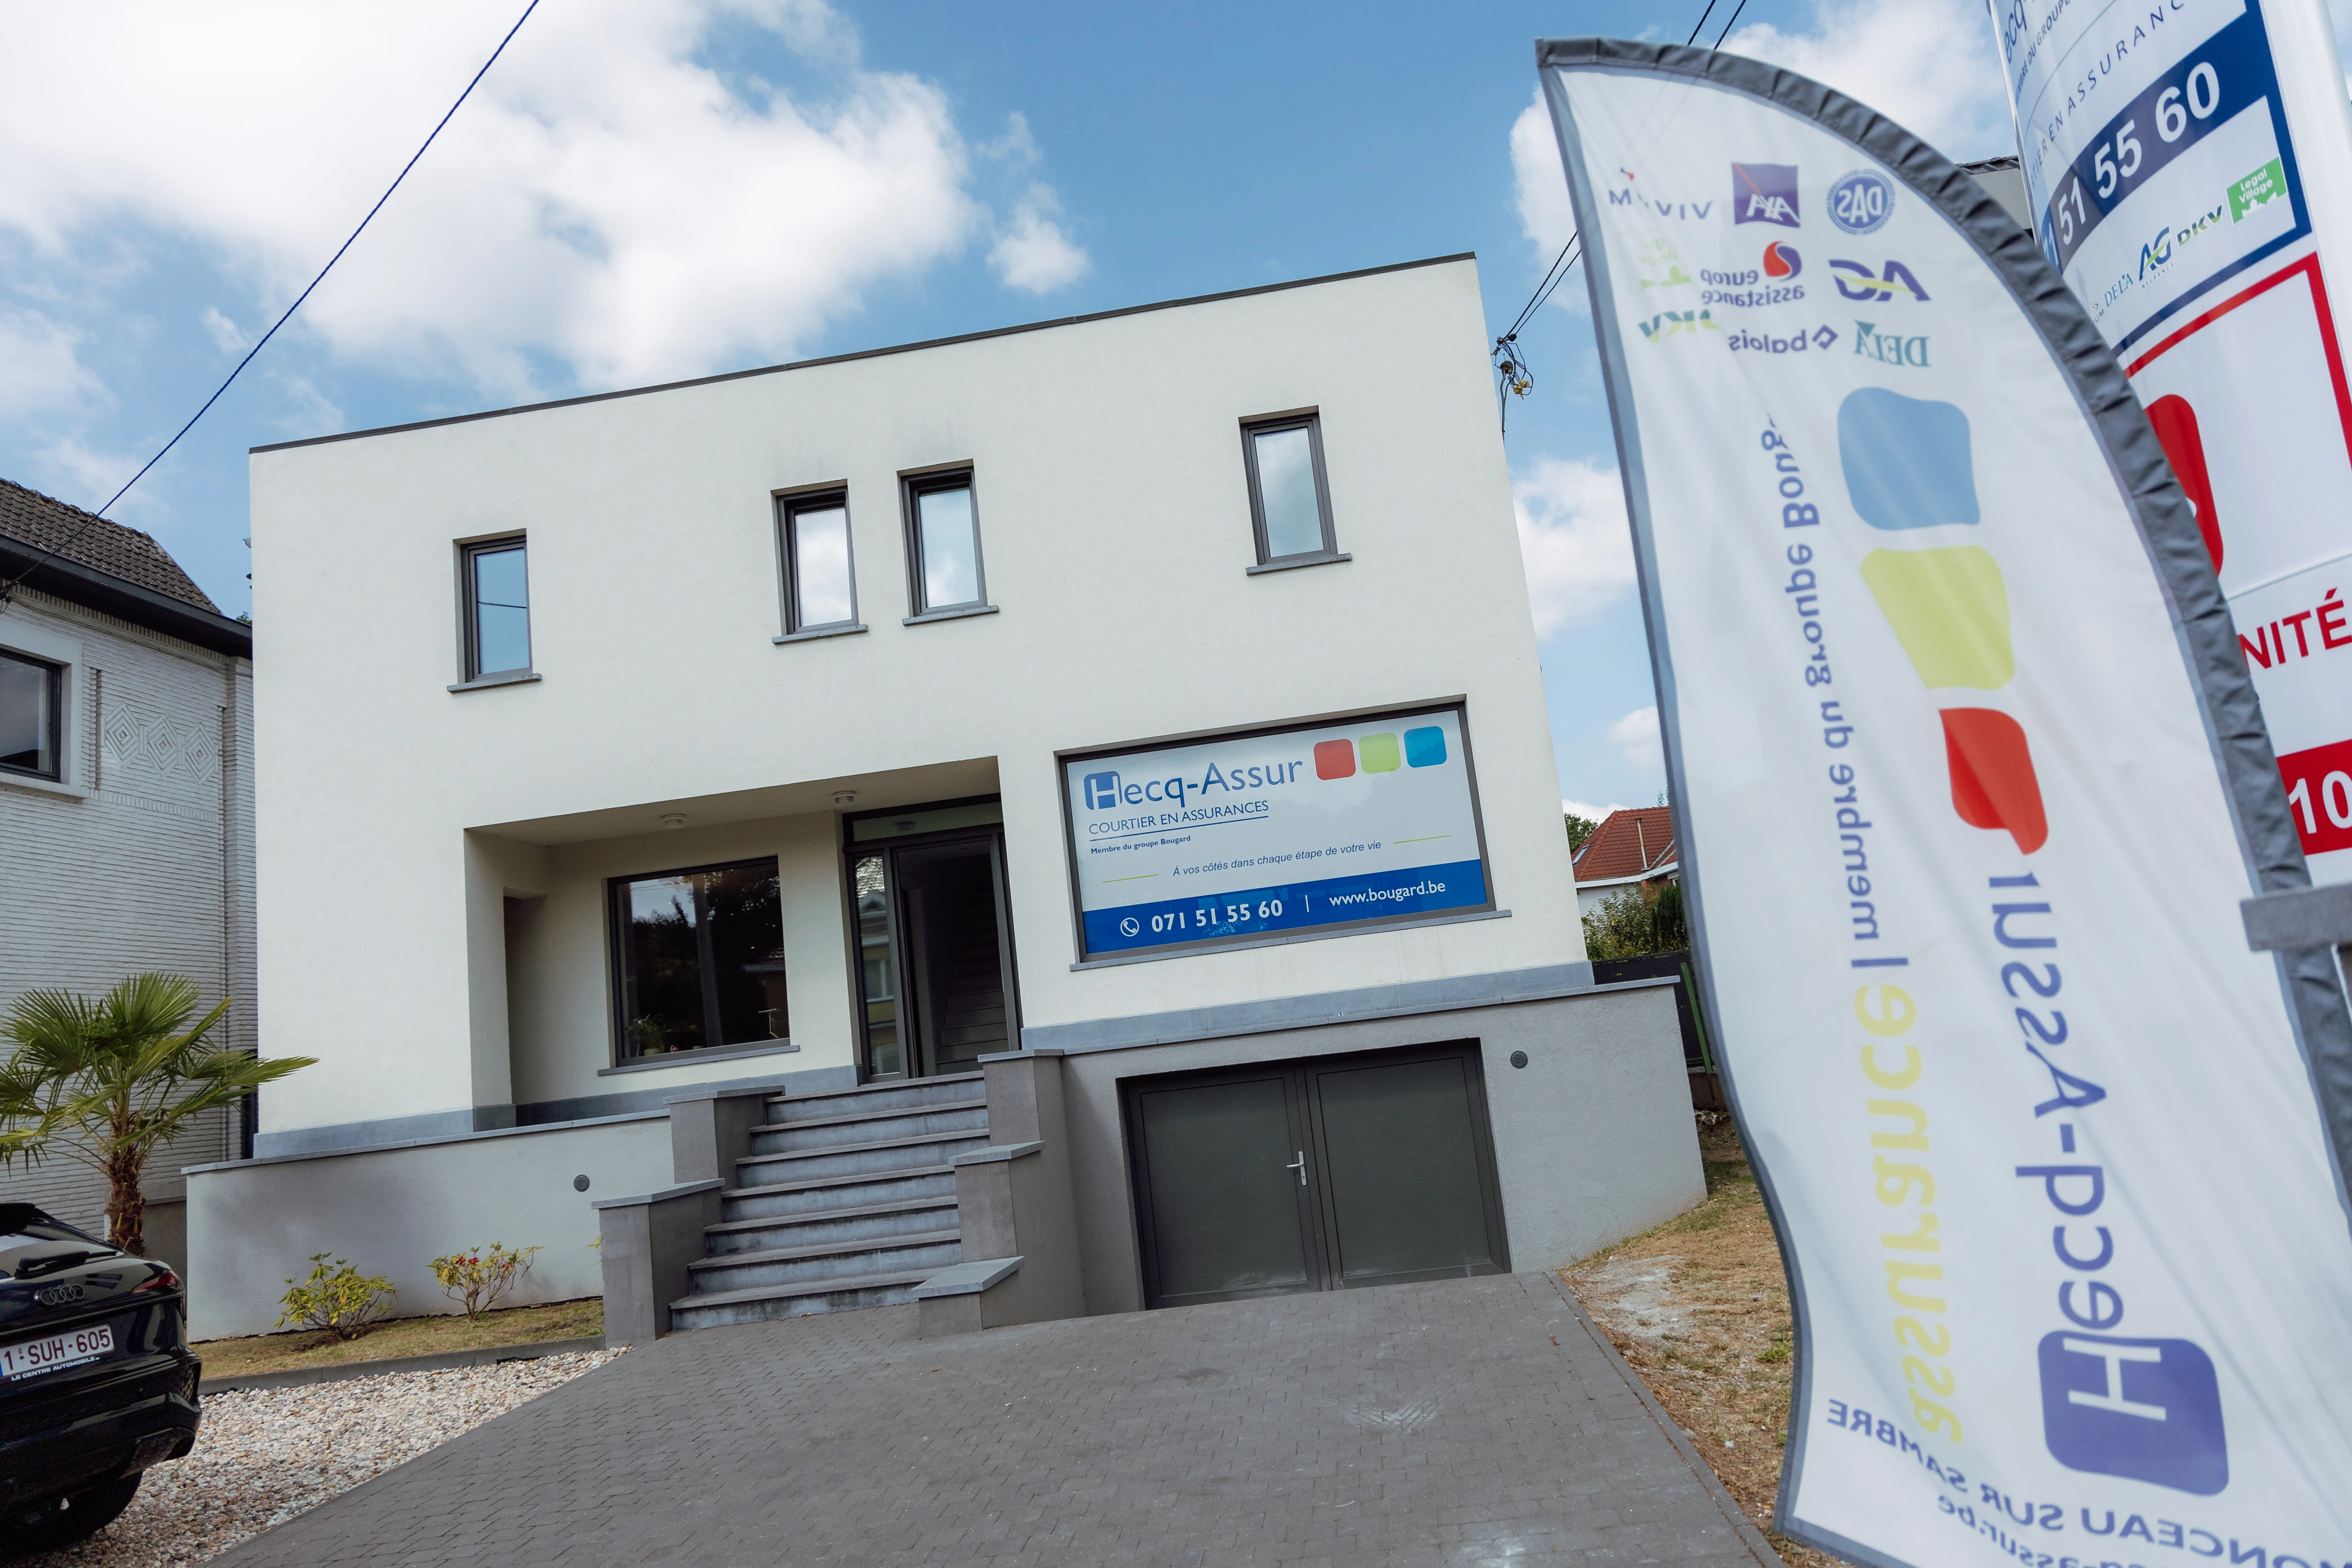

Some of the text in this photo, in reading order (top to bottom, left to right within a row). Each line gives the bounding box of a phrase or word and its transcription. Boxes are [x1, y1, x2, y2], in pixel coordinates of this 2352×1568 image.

[2027, 42, 2036, 65] DU
[2049, 111, 2063, 142] EN
[2058, 176, 2086, 245] 51
[2094, 120, 2142, 199] 55
[2155, 62, 2220, 143] 60
[2239, 179, 2273, 203] Village
[2240, 168, 2267, 192] Legal
[2177, 205, 2222, 247] DKV
[2139, 226, 2171, 282] AG
[2103, 273, 2134, 307] DELA
[2139, 262, 2174, 291] INSURANCE
[1083, 760, 1303, 810] Hecq-Assur
[1089, 800, 1269, 834] COURTIER EN ASSURANCES
[1091, 846, 1121, 854] Membre
[1134, 840, 1159, 850] groupe
[1161, 835, 1191, 845] Bougard
[1173, 841, 1381, 876] À vos côtés dans chaque étape de votre vie
[1151, 880, 1446, 932] 071 51 55 60 www.bougard.be
[22, 1367, 51, 1379] CENTRE
